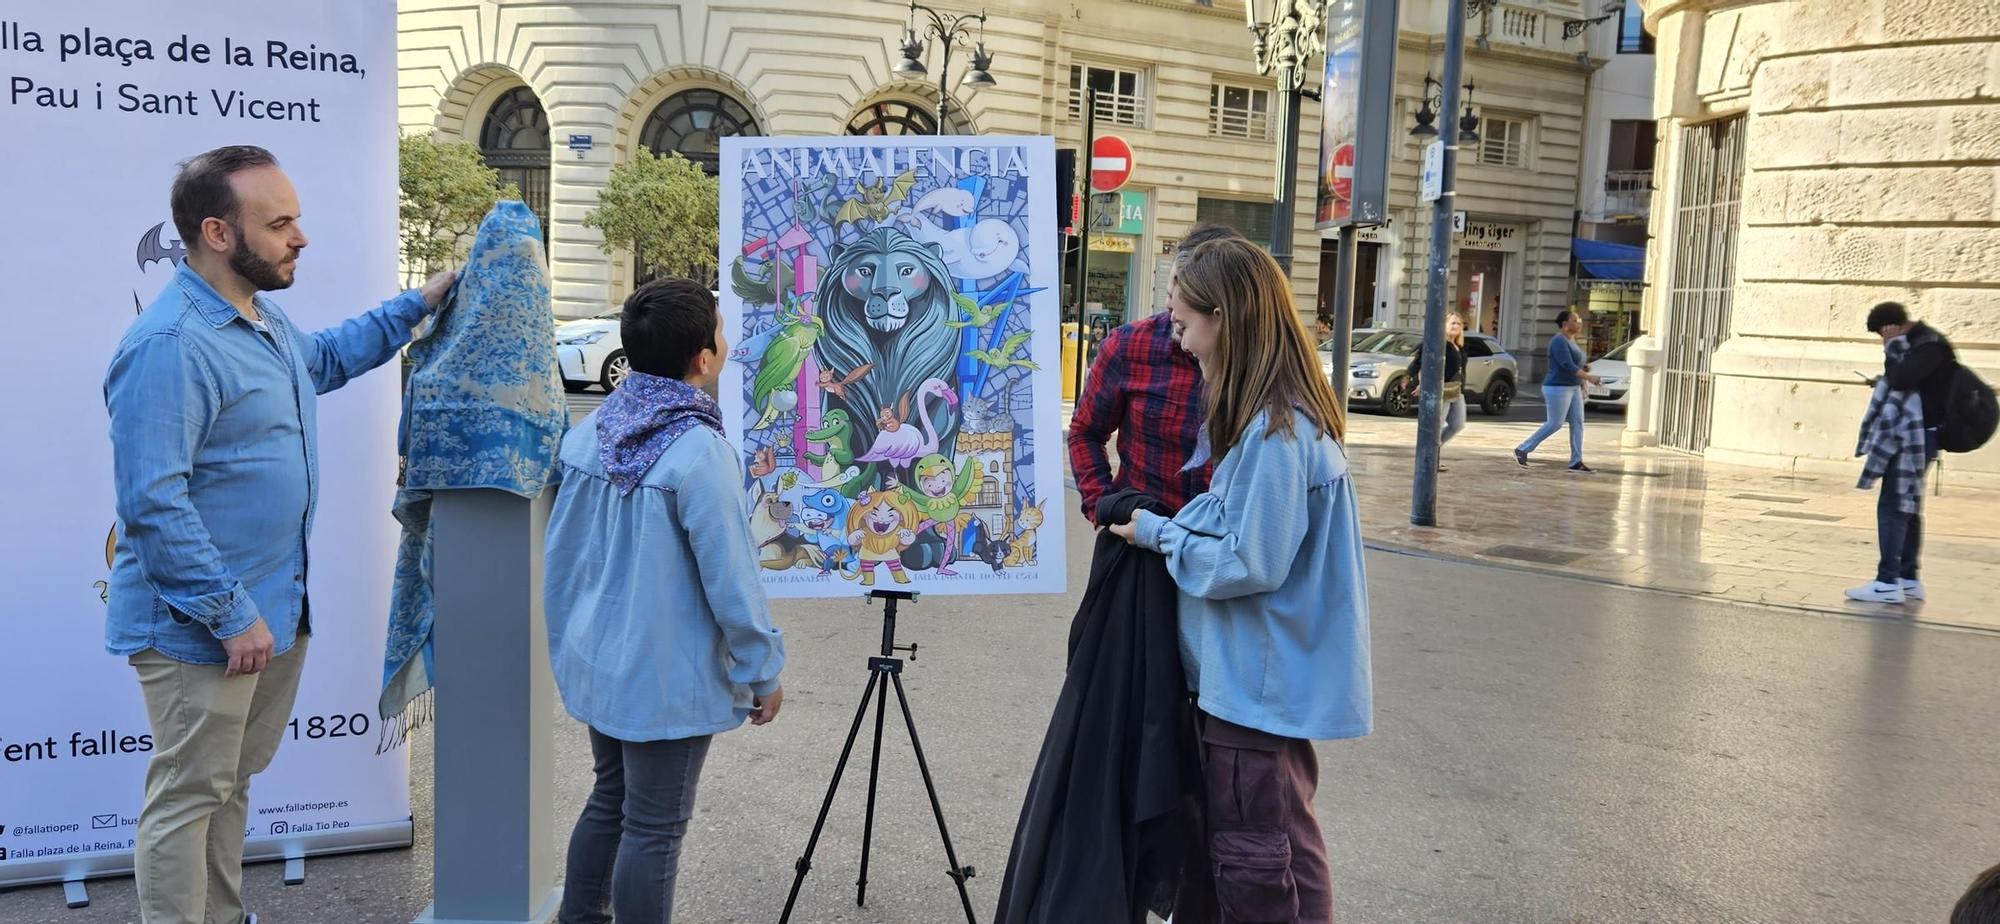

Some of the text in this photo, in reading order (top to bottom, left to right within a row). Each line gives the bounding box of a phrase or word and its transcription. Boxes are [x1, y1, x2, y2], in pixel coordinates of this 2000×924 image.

[59, 27, 154, 67] plaça
[167, 34, 211, 64] de
[224, 37, 254, 67] la
[266, 40, 367, 79] Reina,
[11, 76, 321, 123] Pau i Sant Vicent
[742, 146, 1030, 180] ANIMALENCIA
[0, 713, 370, 762] ent falles 1820
[258, 799, 349, 815] www.fallatiopep.es
[12, 822, 80, 837] @fallatiopep
[292, 824, 313, 833] Falla
[333, 820, 350, 829] Pep
[11, 848, 34, 858] Falla
[37, 846, 64, 857] plaza
[66, 844, 80, 853] de
[82, 843, 91, 852] la
[94, 840, 125, 851] Reina,
